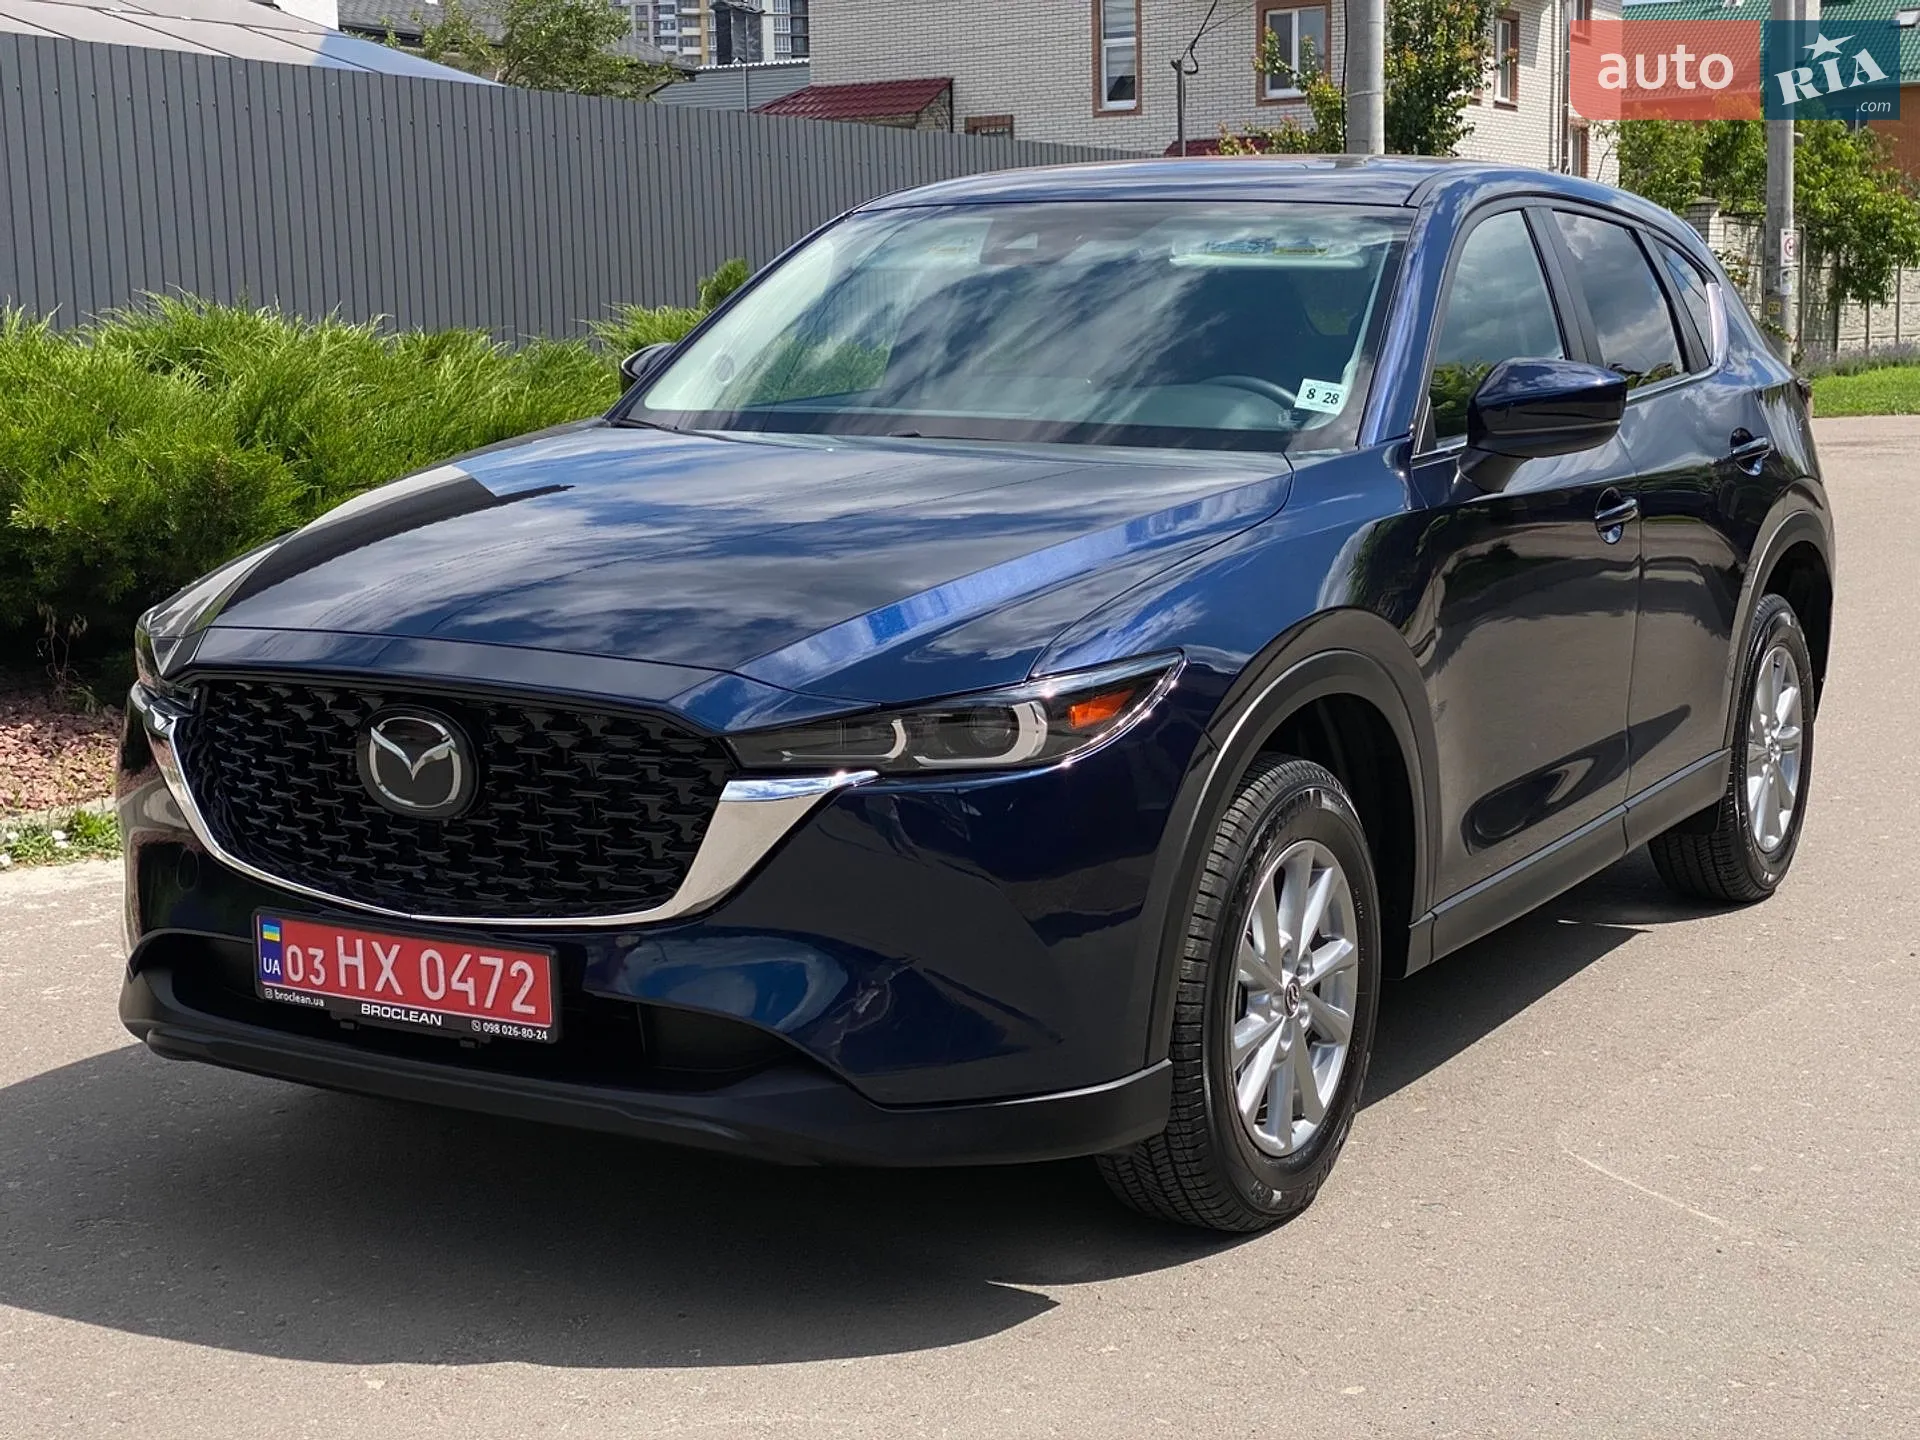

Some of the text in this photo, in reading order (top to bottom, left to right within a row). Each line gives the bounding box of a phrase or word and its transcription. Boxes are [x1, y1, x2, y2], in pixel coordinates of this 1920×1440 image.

[1307, 388, 1340, 404] 8 28
[263, 957, 281, 976] UA
[286, 935, 536, 1015] 03 HX 0472
[274, 988, 325, 1008] broclean.ua
[361, 1003, 442, 1026] BROCLEAN
